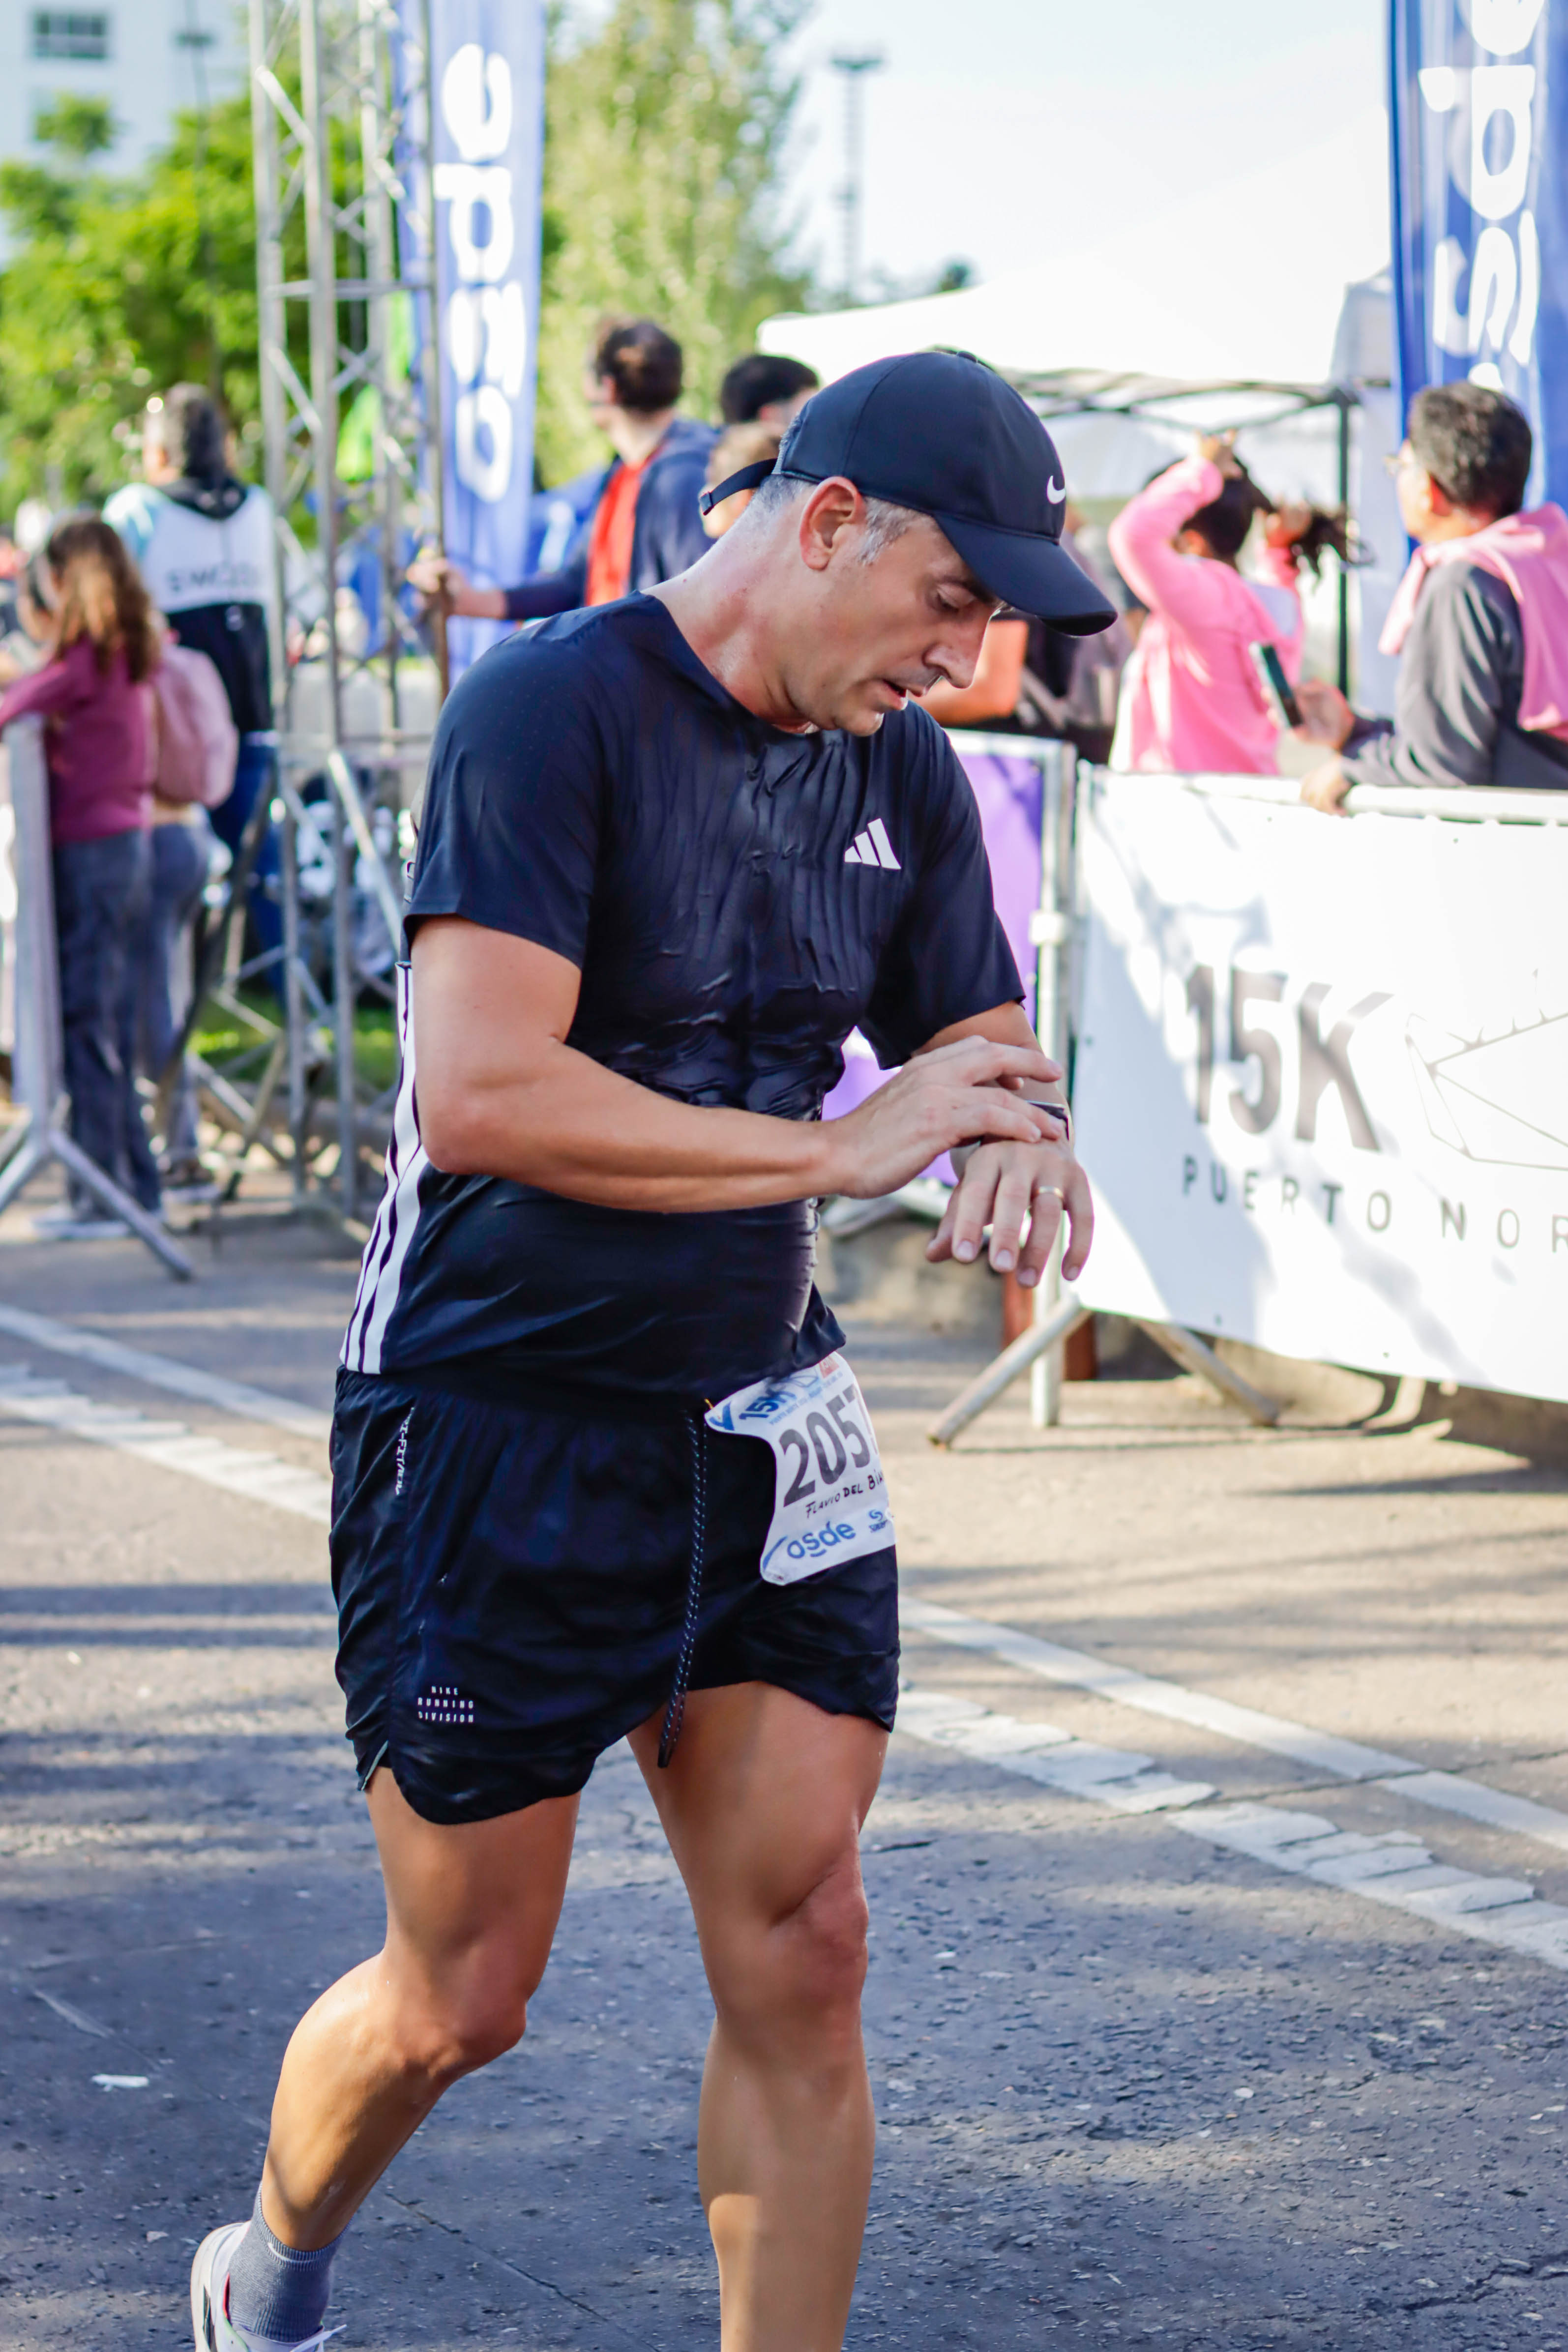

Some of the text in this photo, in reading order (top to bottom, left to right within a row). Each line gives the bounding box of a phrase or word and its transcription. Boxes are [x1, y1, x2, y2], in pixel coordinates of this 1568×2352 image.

[434, 43, 526, 502] osde
[1185, 964, 1394, 1153] 15K
[1182, 1154, 1392, 1232] PUERTO
[843, 1483, 863, 1498] DEL
[787, 1521, 856, 1559] osde
[417, 1697, 474, 1709] RUNNING
[431, 1685, 458, 1696] NIKE
[418, 1710, 474, 1723] DIVISION
